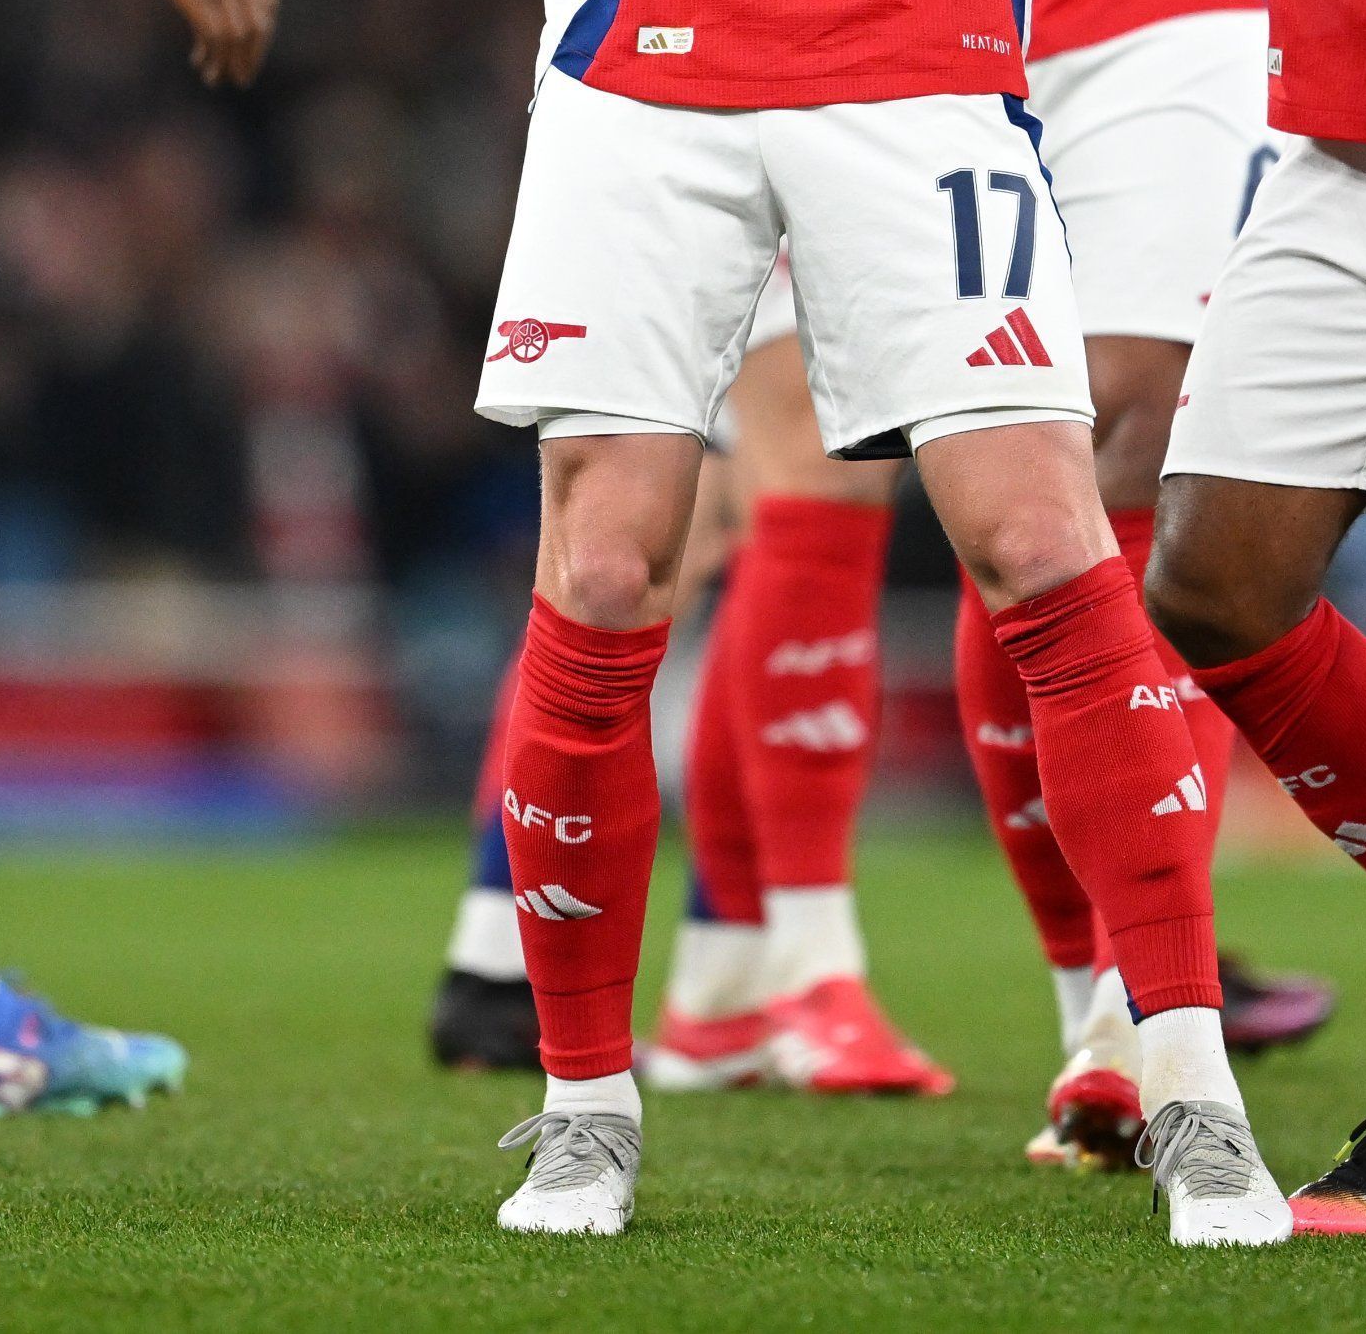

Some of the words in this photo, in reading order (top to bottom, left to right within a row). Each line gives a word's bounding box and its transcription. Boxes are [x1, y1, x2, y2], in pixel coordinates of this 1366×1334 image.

[936, 167, 1038, 300] 17
[1129, 684, 1184, 714] AF
[504, 787, 592, 844] AFC
